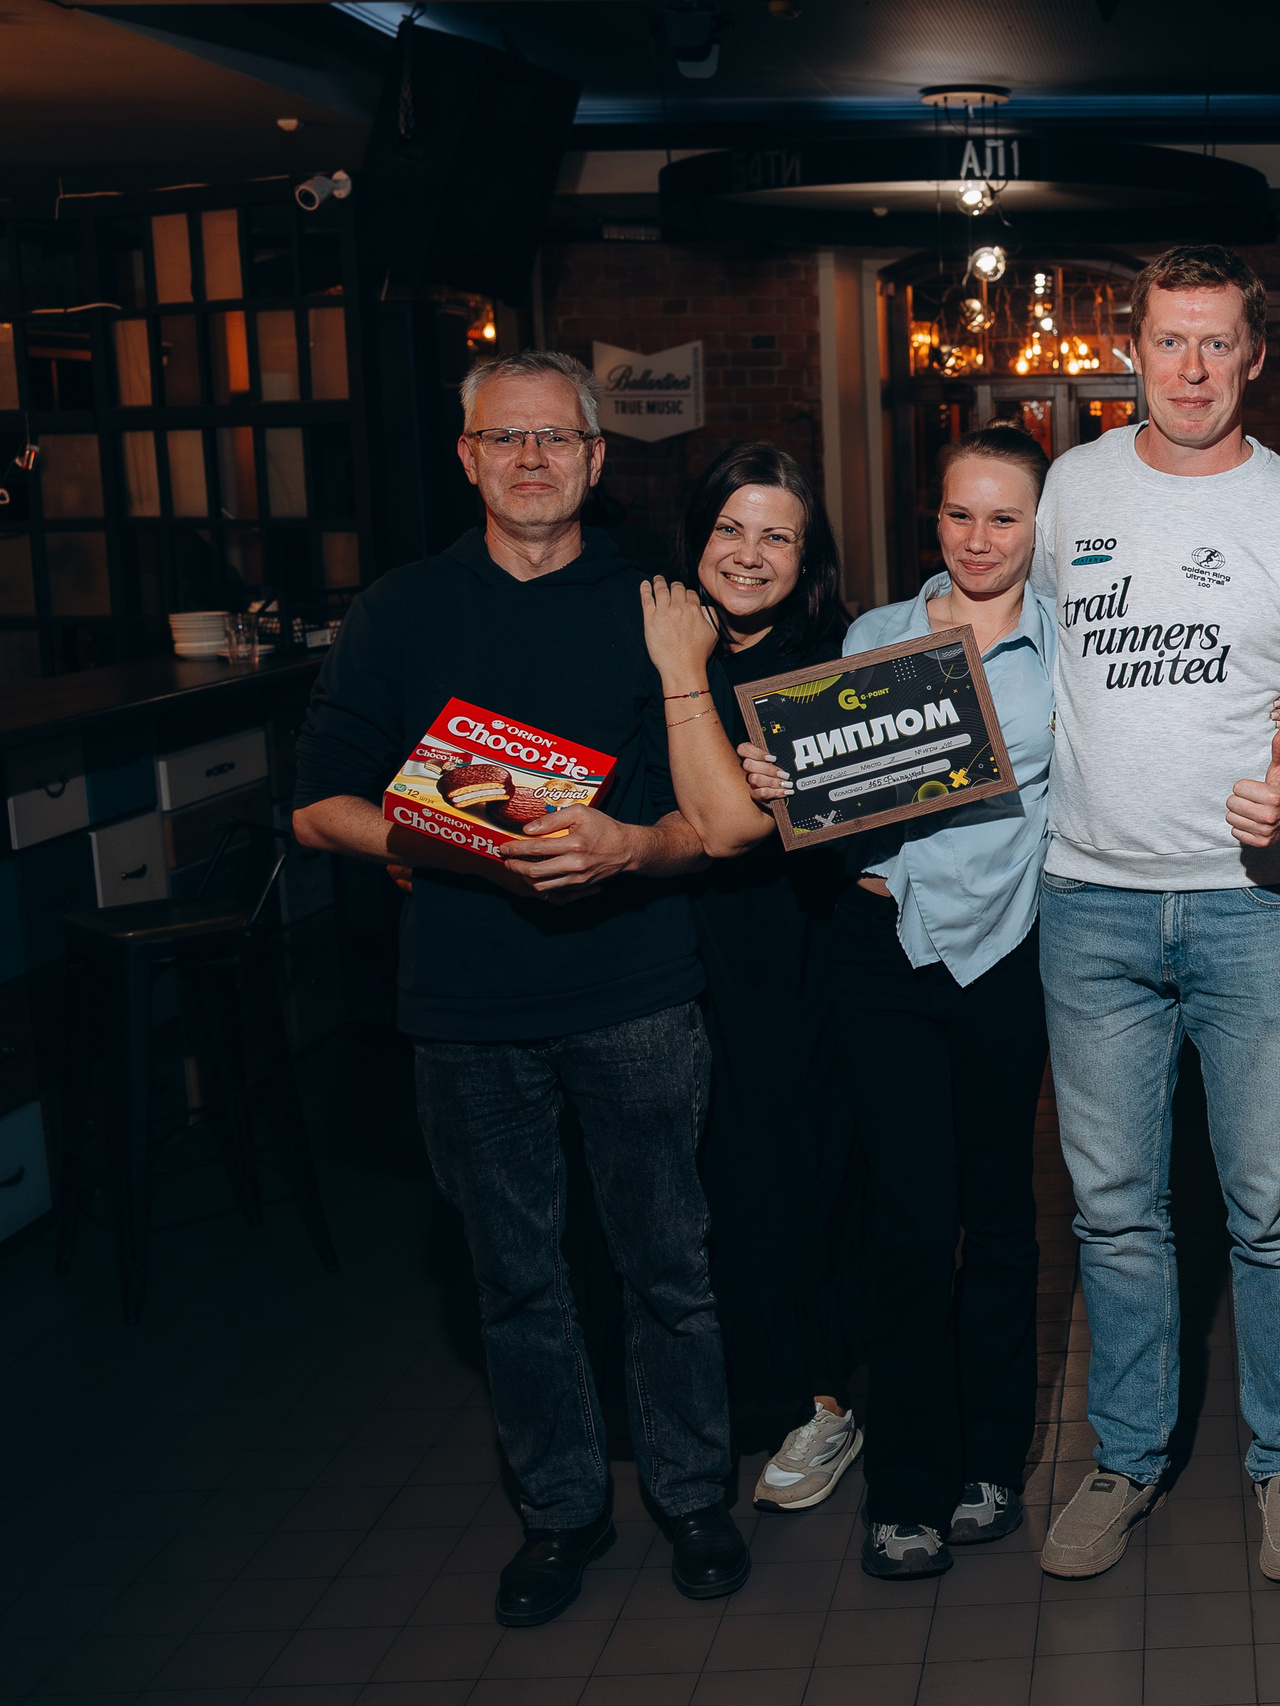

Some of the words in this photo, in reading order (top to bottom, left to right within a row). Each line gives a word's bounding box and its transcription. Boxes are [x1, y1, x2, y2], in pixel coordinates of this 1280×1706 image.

[614, 400, 642, 415] TRUE
[646, 400, 684, 415] MUSIC
[1075, 538, 1117, 552] T100
[1181, 565, 1211, 576] Golden
[1212, 571, 1231, 583] Ring
[1185, 573, 1206, 582] Ultra
[1207, 577, 1225, 586] Trail
[1197, 581, 1211, 589] 100
[1062, 575, 1132, 628] trail
[1082, 623, 1220, 657] runners
[1106, 644, 1231, 690] united
[507, 725, 555, 748] ORION
[791, 698, 961, 771] ДИПЛОМ
[801, 779, 817, 788] Дата
[860, 761, 882, 771] Место
[923, 745, 938, 754] игры
[407, 788, 420, 798] 12
[534, 787, 588, 800] Original
[834, 785, 863, 798] Команда
[434, 813, 471, 831] ORION
